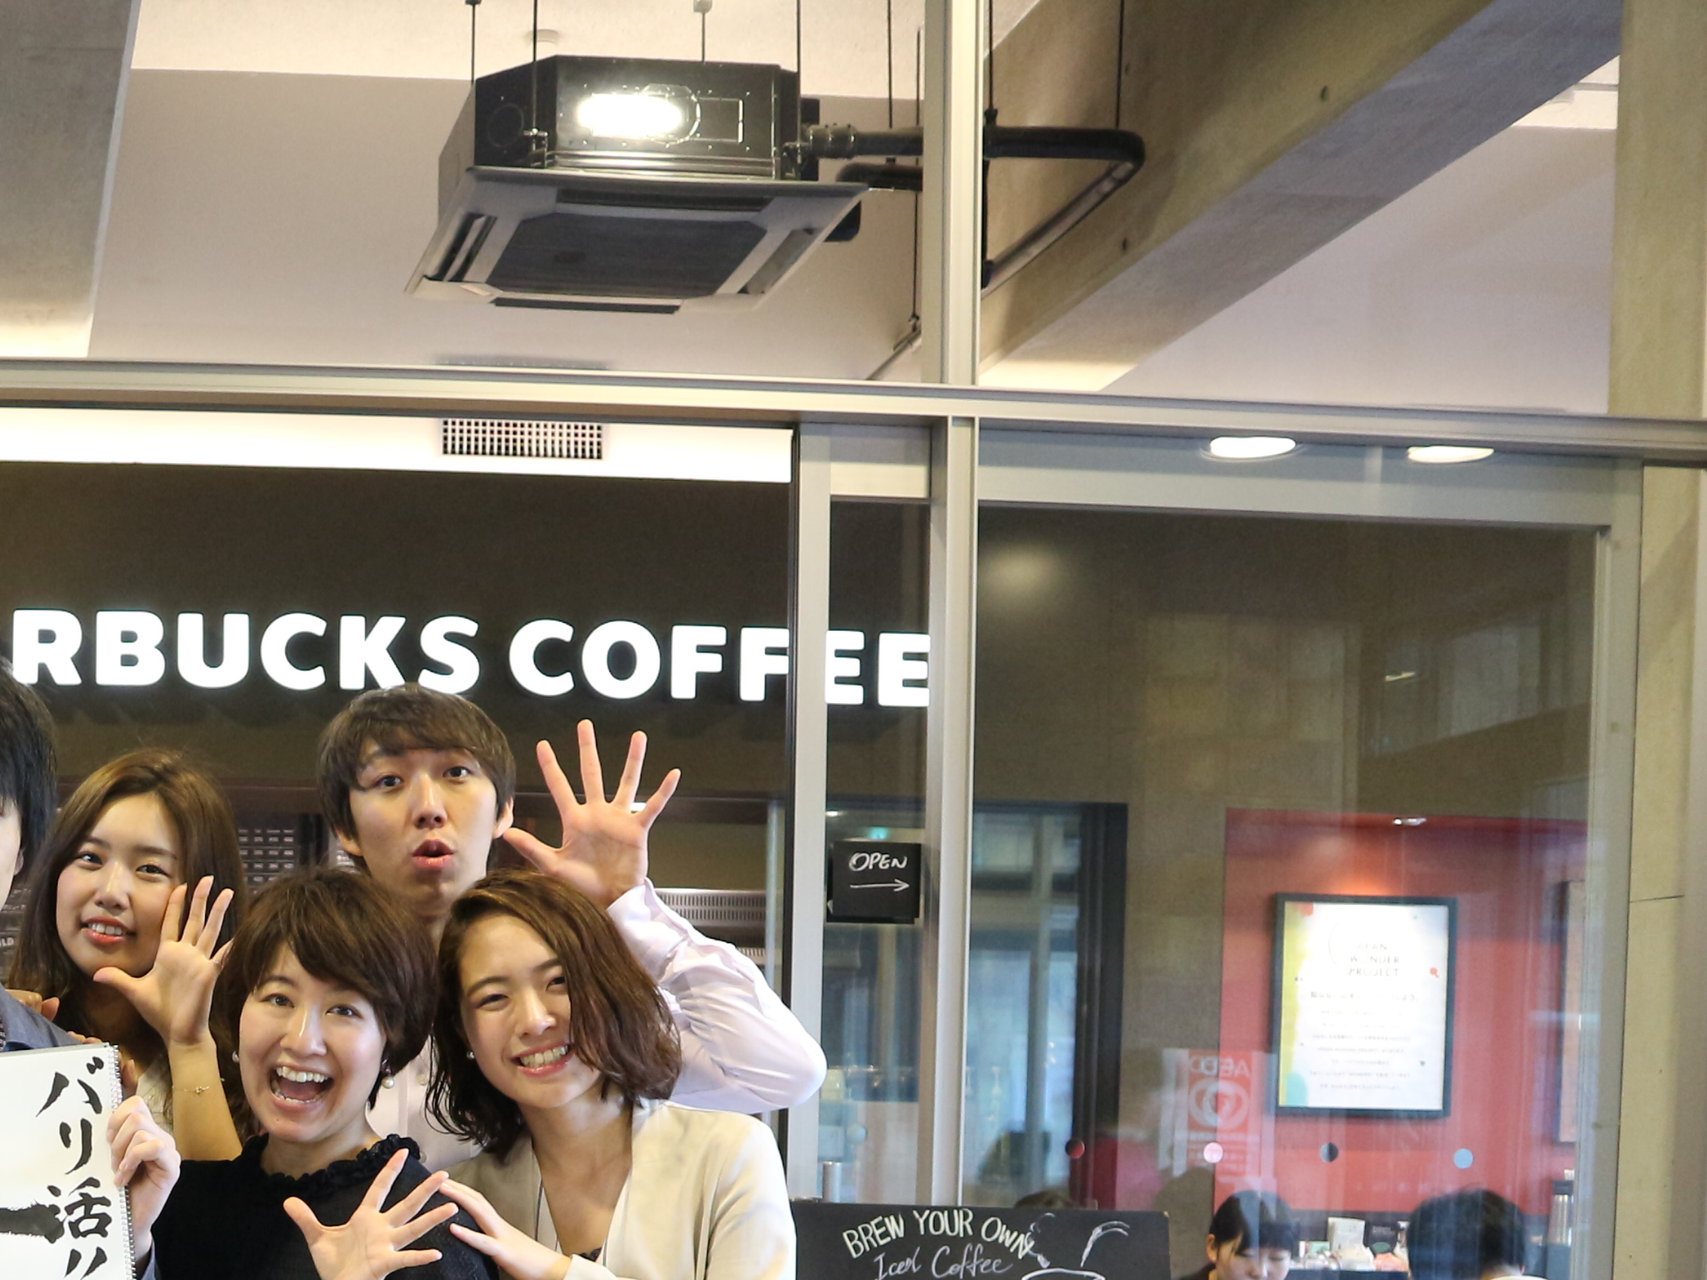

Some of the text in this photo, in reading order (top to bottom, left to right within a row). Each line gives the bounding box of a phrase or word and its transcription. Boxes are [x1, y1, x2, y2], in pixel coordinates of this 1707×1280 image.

[508, 618, 931, 708] COFFEE
[849, 852, 908, 871] OPEN
[842, 1208, 1035, 1259] BREW YOUR OWN
[931, 1244, 1014, 1279] Coffee
